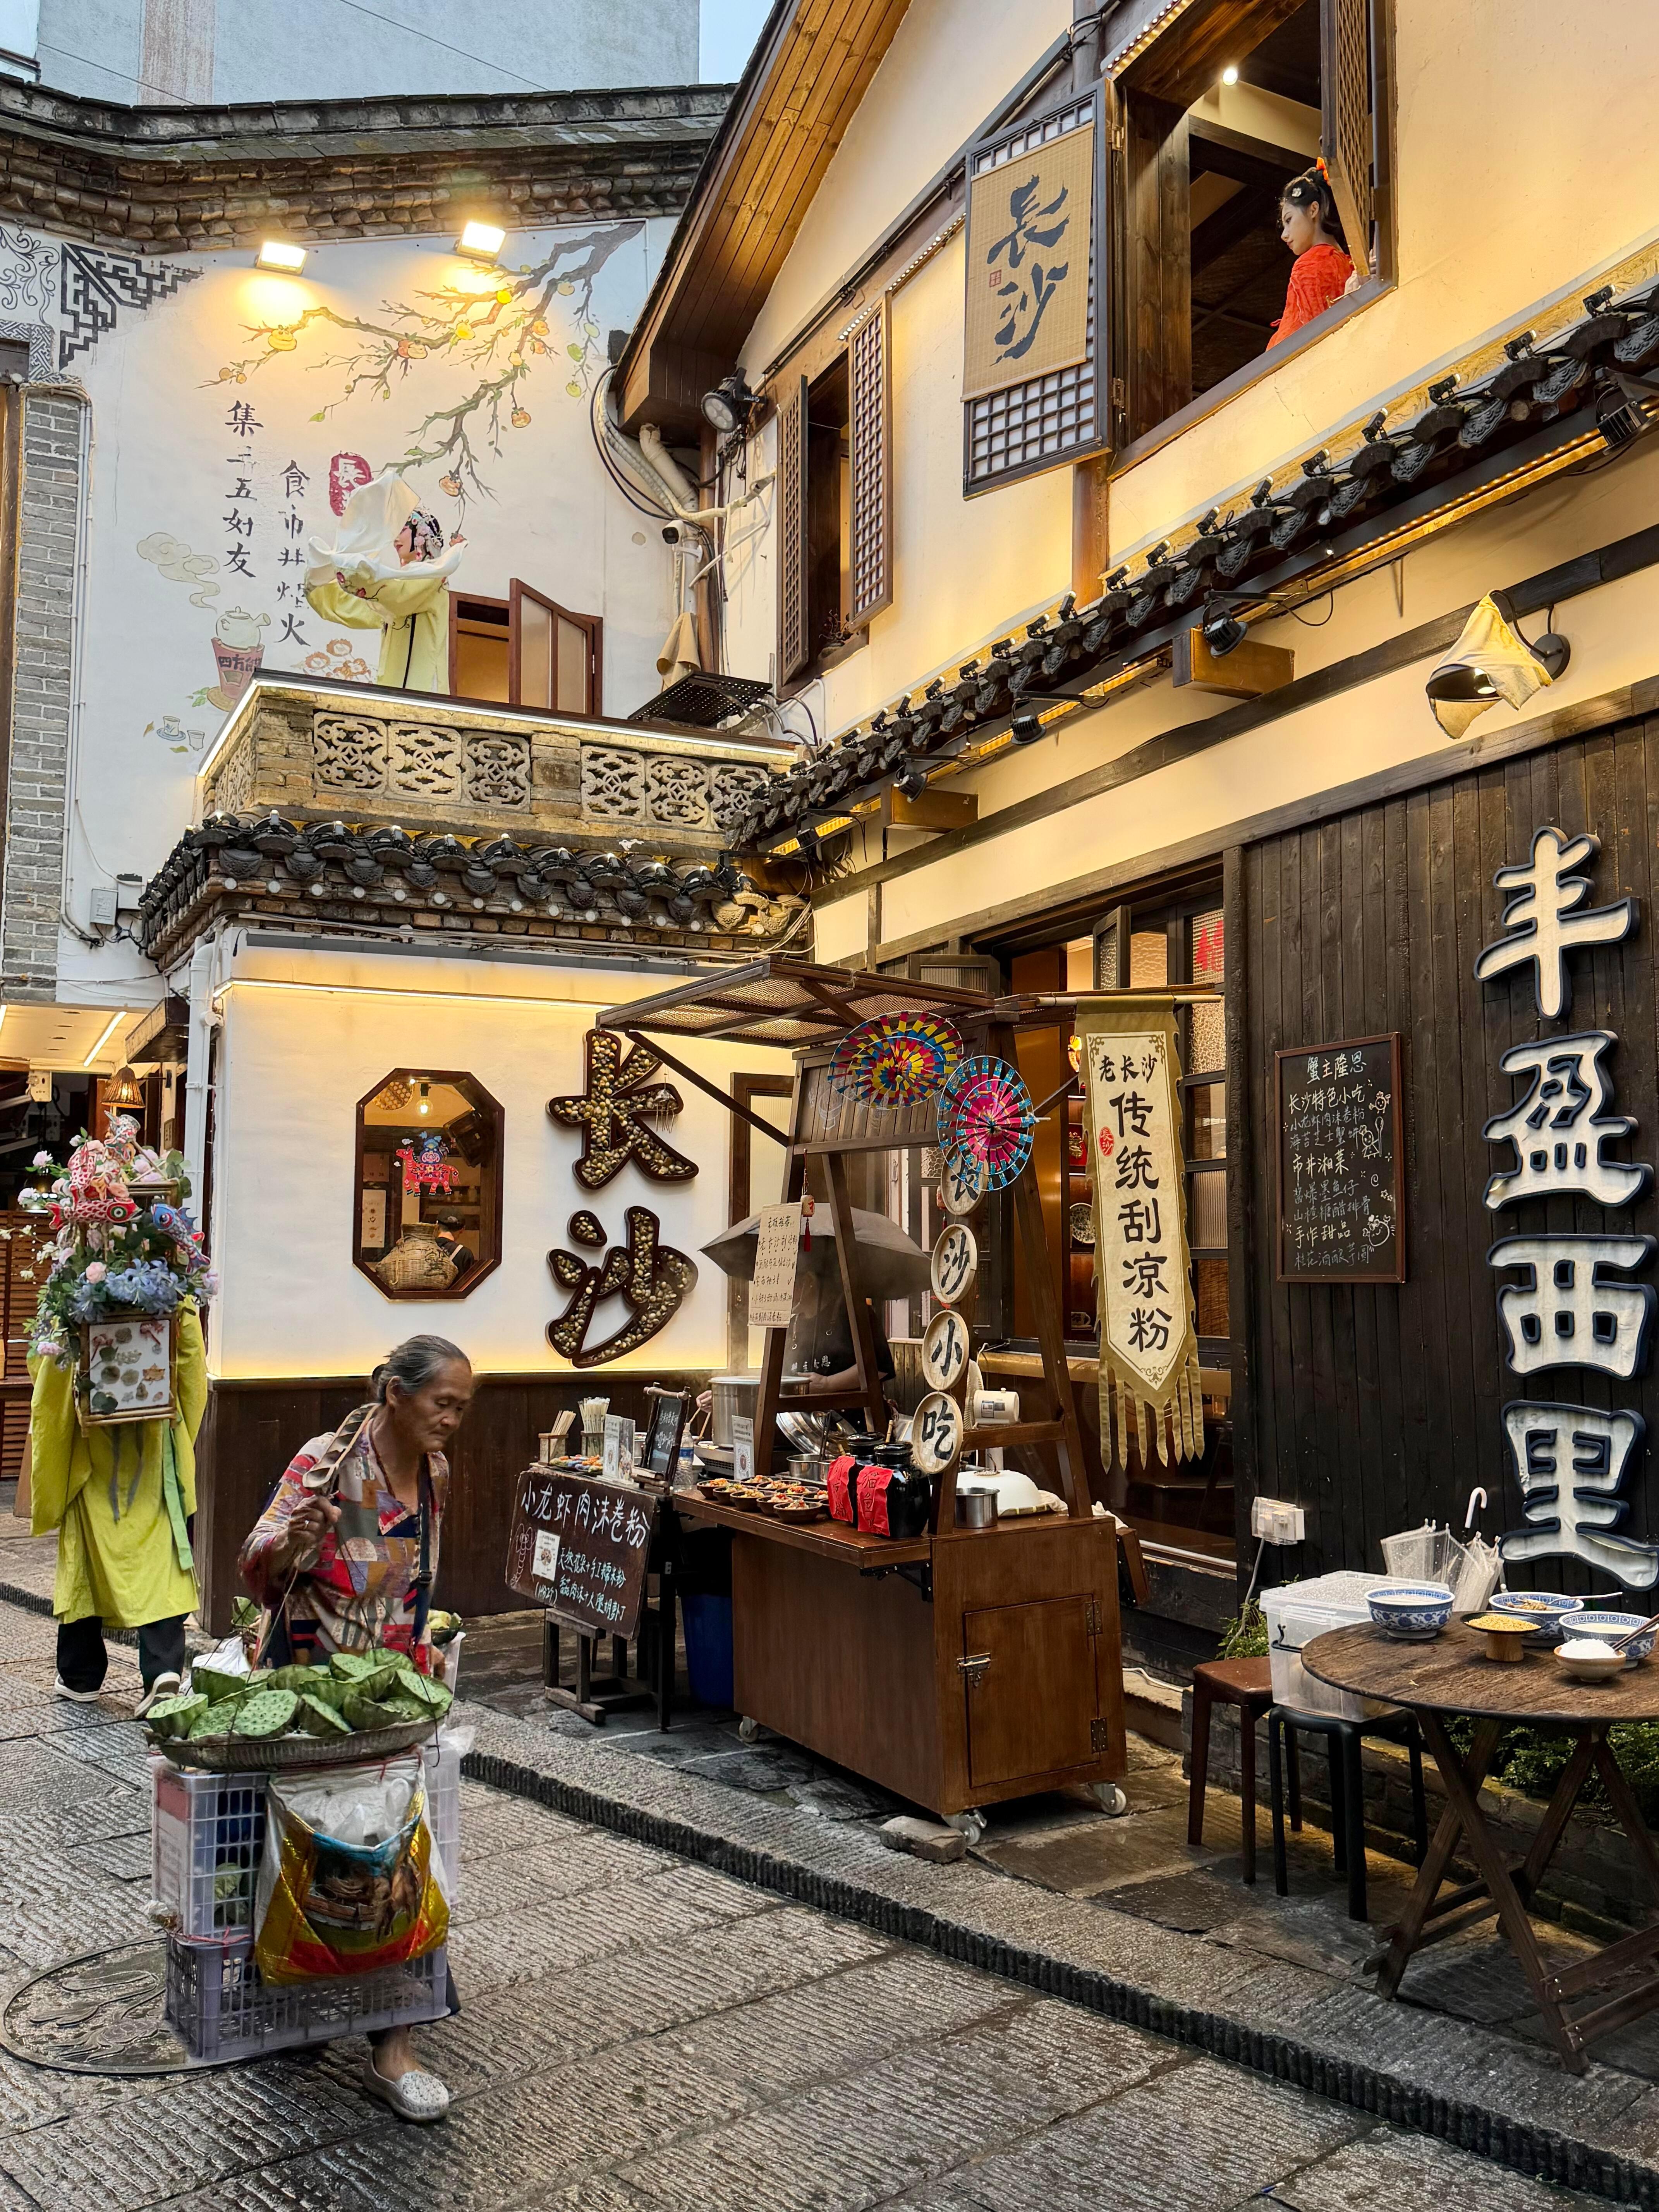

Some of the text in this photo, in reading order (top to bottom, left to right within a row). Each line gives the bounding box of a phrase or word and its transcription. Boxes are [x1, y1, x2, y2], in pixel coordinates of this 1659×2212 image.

[1098, 1054, 1158, 1083] 老长沙
[1307, 1051, 1367, 1084] 蟹主隆恩
[1289, 1084, 1365, 1115] 长沙特色小吃
[1293, 1148, 1349, 1187] 市井湘菜
[546, 1028, 699, 1369] 长沙
[1294, 1195, 1370, 1223] 山楂糖醋排骨
[1474, 825, 1659, 1592] 丰盈西里
[1109, 1091, 1170, 1353] 传统刮凉粉
[1295, 1220, 1351, 1249] 手作甜品
